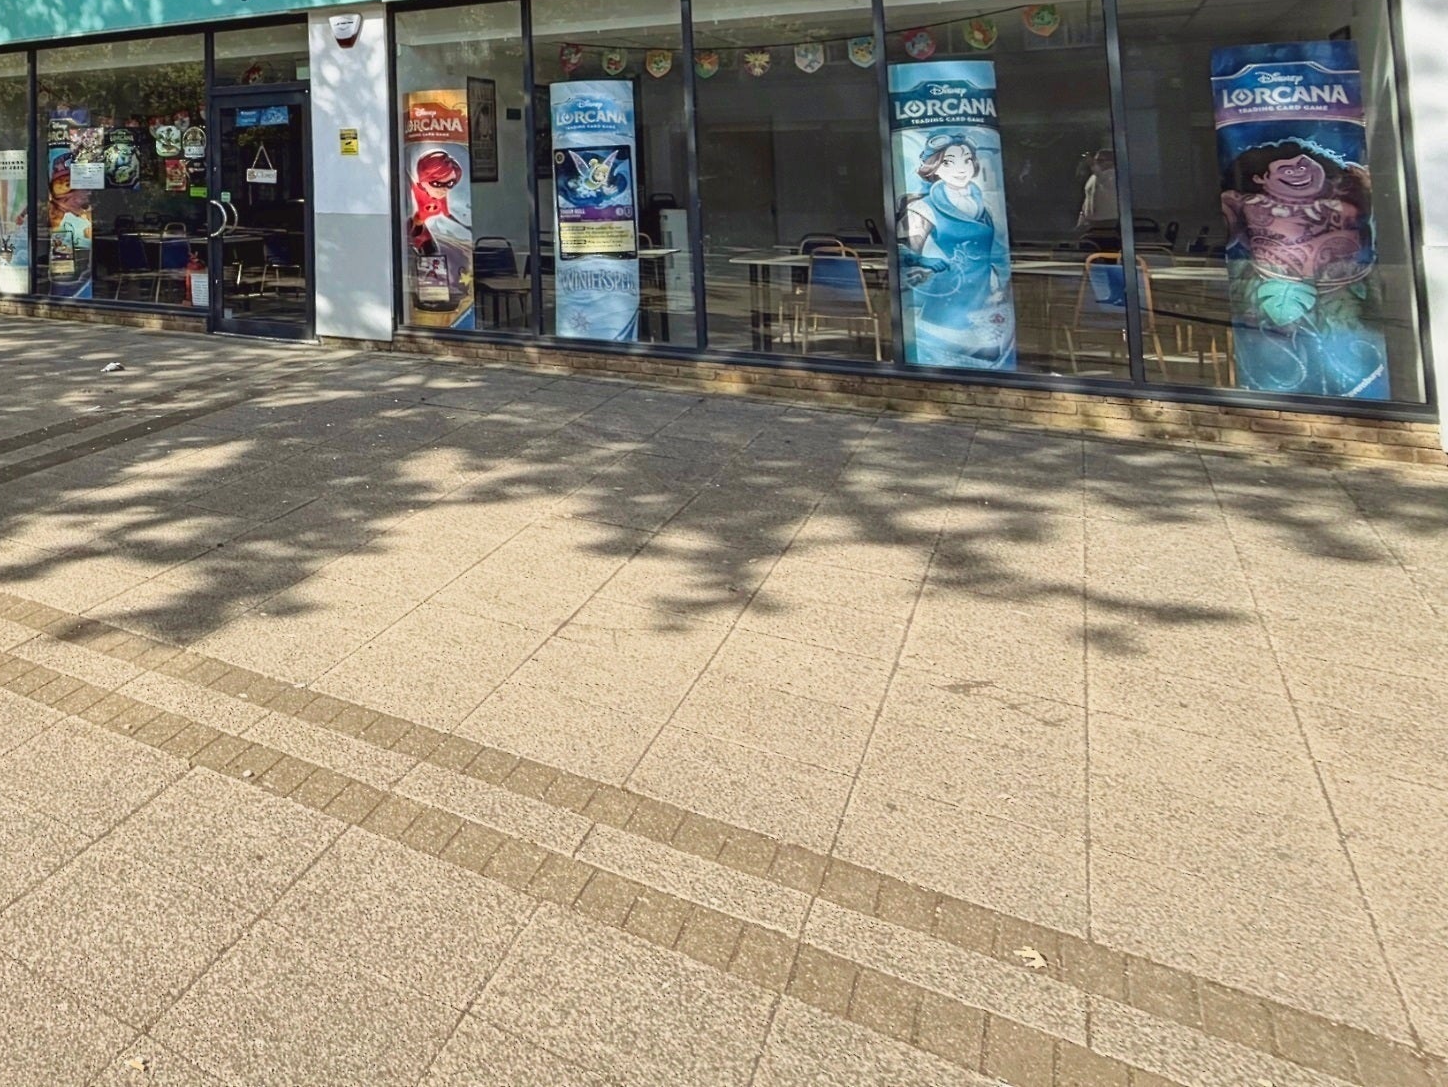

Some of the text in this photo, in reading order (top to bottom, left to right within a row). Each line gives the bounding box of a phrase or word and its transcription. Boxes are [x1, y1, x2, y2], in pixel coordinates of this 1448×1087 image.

[1255, 71, 1304, 85] Disney
[926, 83, 967, 97] Disney
[1222, 84, 1350, 109] LORCANA
[575, 98, 603, 110] Disney
[894, 98, 997, 120] LORCANA
[1238, 105, 1273, 114] TRADING
[1276, 104, 1301, 112] CARD
[556, 110, 628, 126] LORCANA
[911, 117, 944, 125] TRADING
